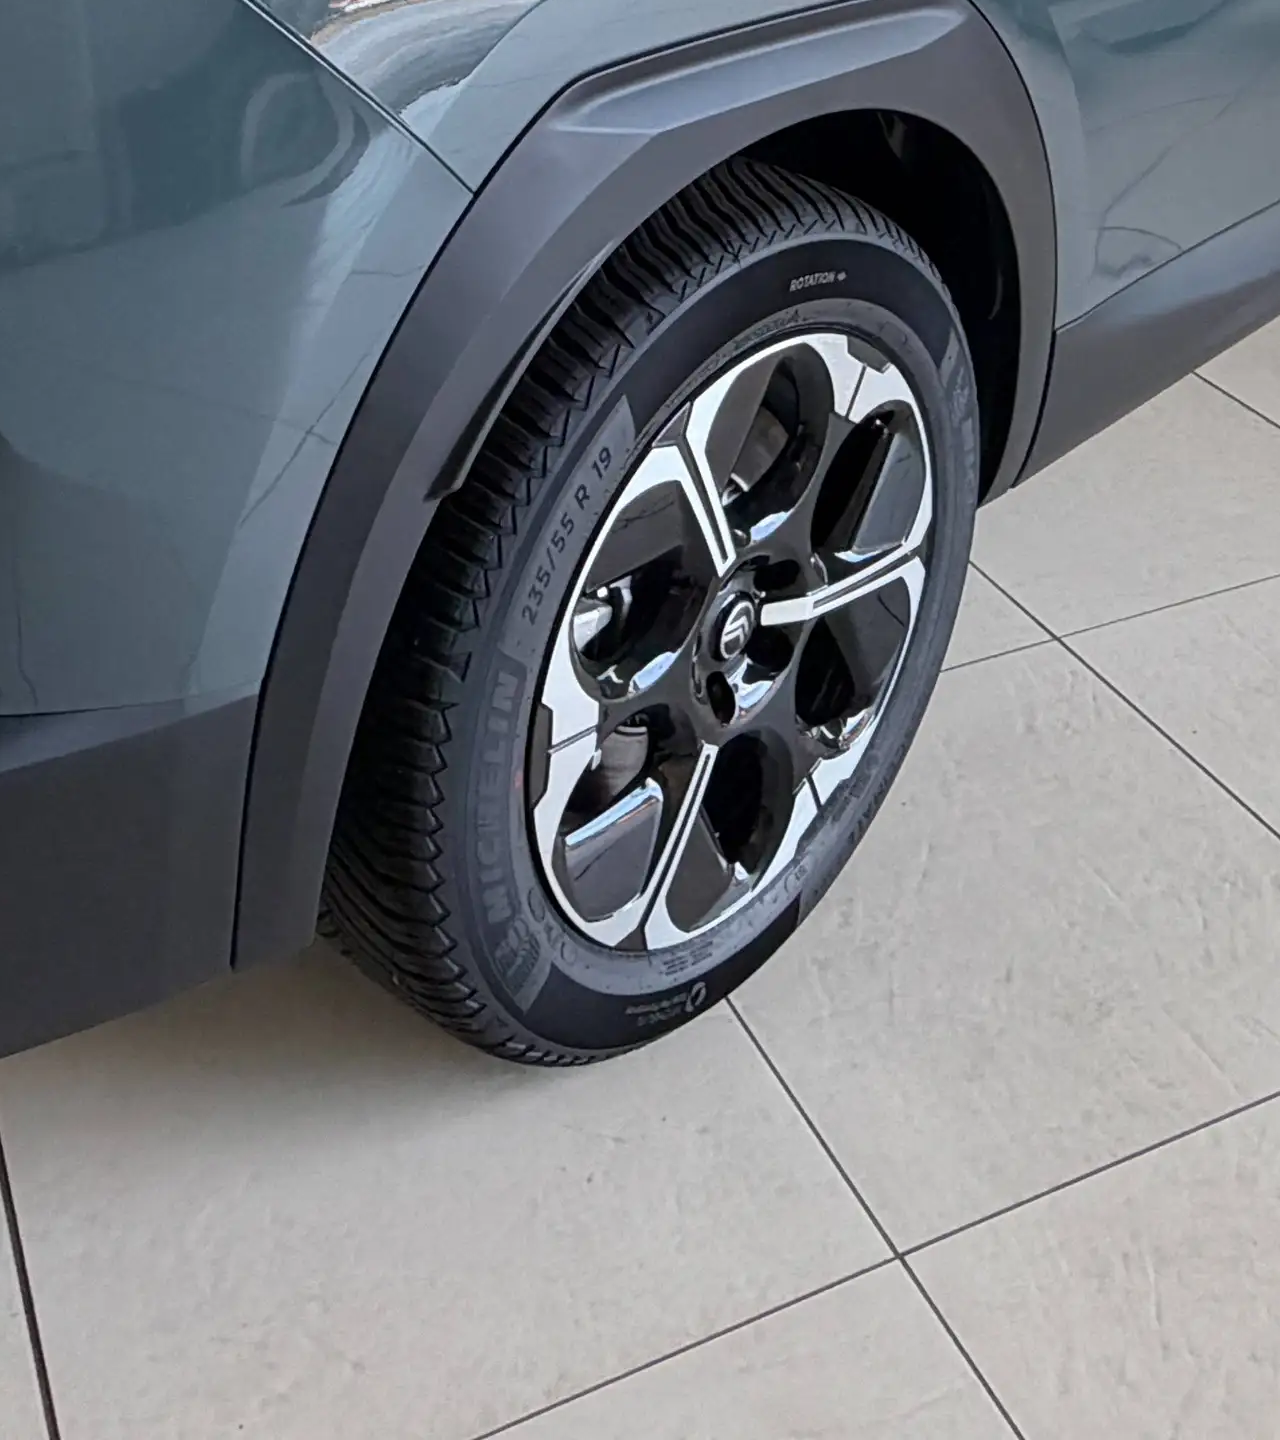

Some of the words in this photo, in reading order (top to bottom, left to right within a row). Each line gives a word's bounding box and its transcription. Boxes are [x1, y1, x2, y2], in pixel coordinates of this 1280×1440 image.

[789, 271, 837, 292] ROTATION
[521, 511, 575, 626] 235/55
[574, 483, 590, 510] R
[591, 446, 613, 480] 19
